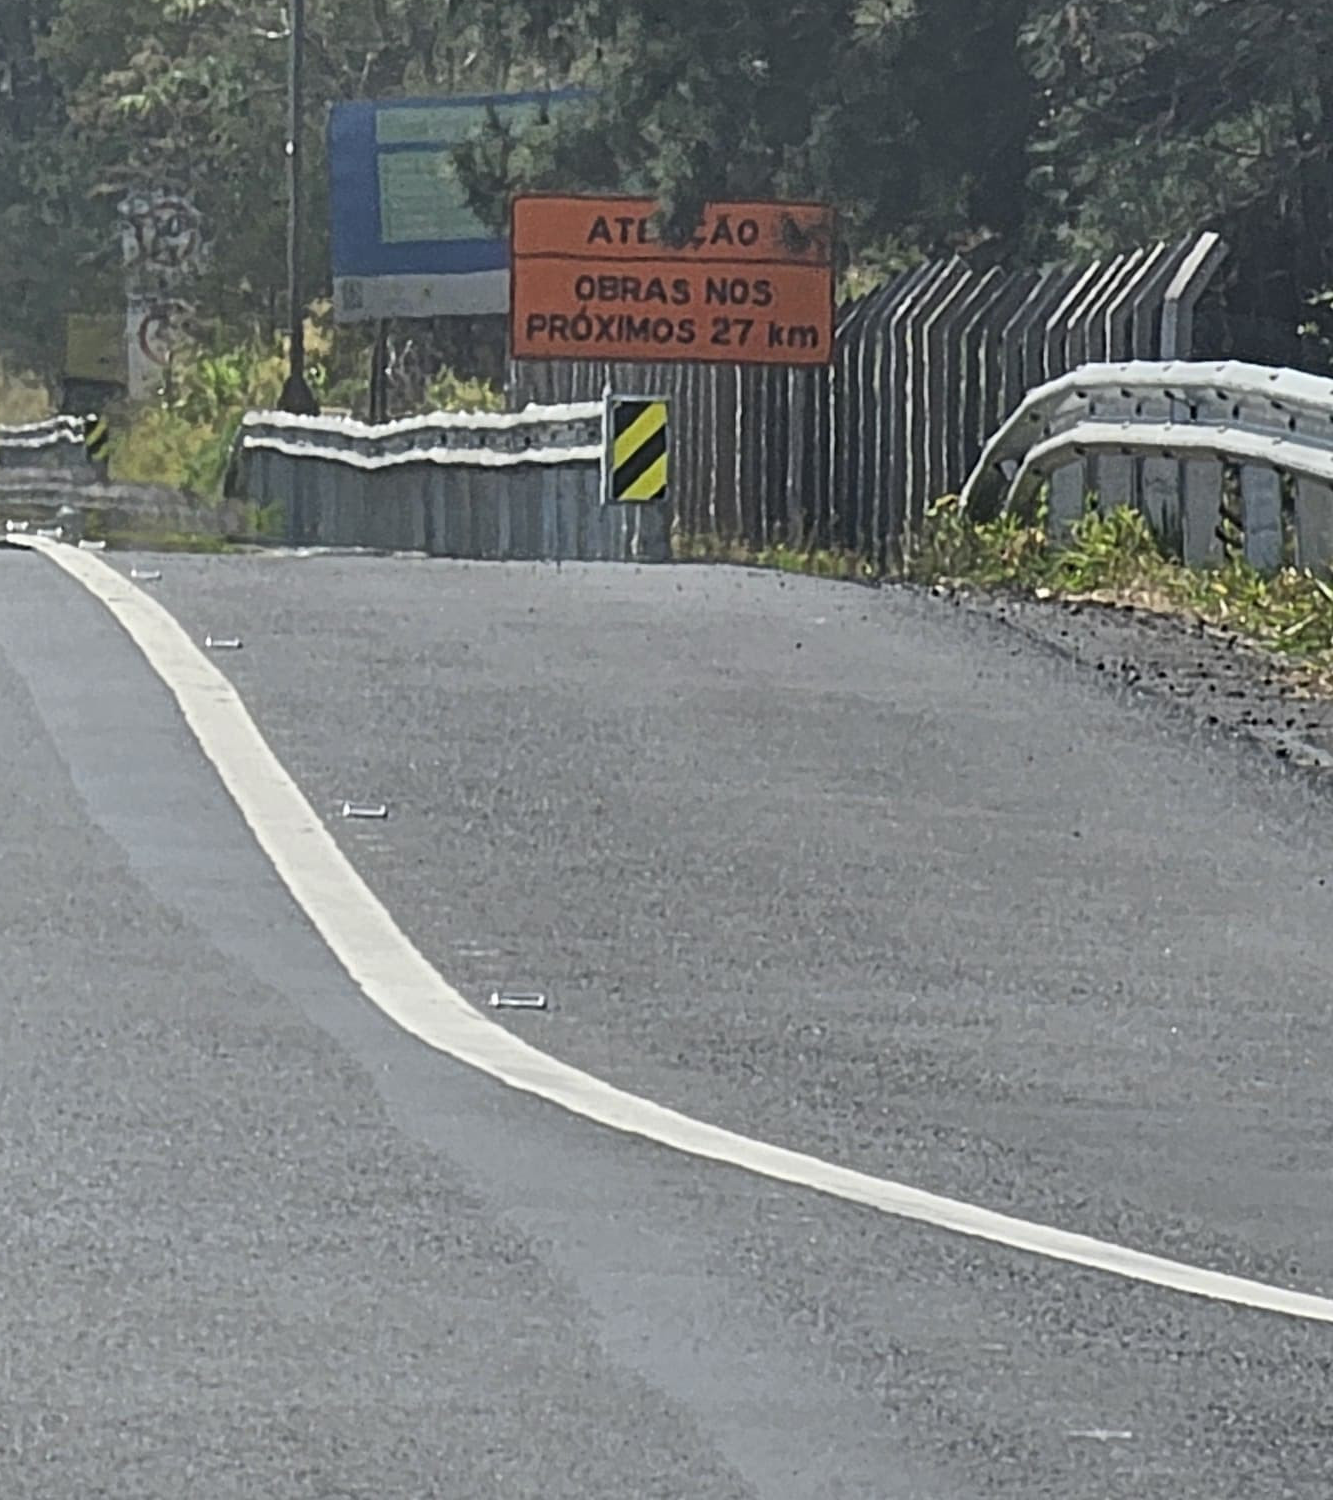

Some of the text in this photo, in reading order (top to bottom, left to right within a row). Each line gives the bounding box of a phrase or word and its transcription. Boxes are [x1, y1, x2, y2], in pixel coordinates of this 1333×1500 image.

[586, 213, 760, 251] ATEÃO
[575, 274, 774, 307] OBRAS NOS
[525, 306, 820, 349] PRÓXIMOS 27 km
